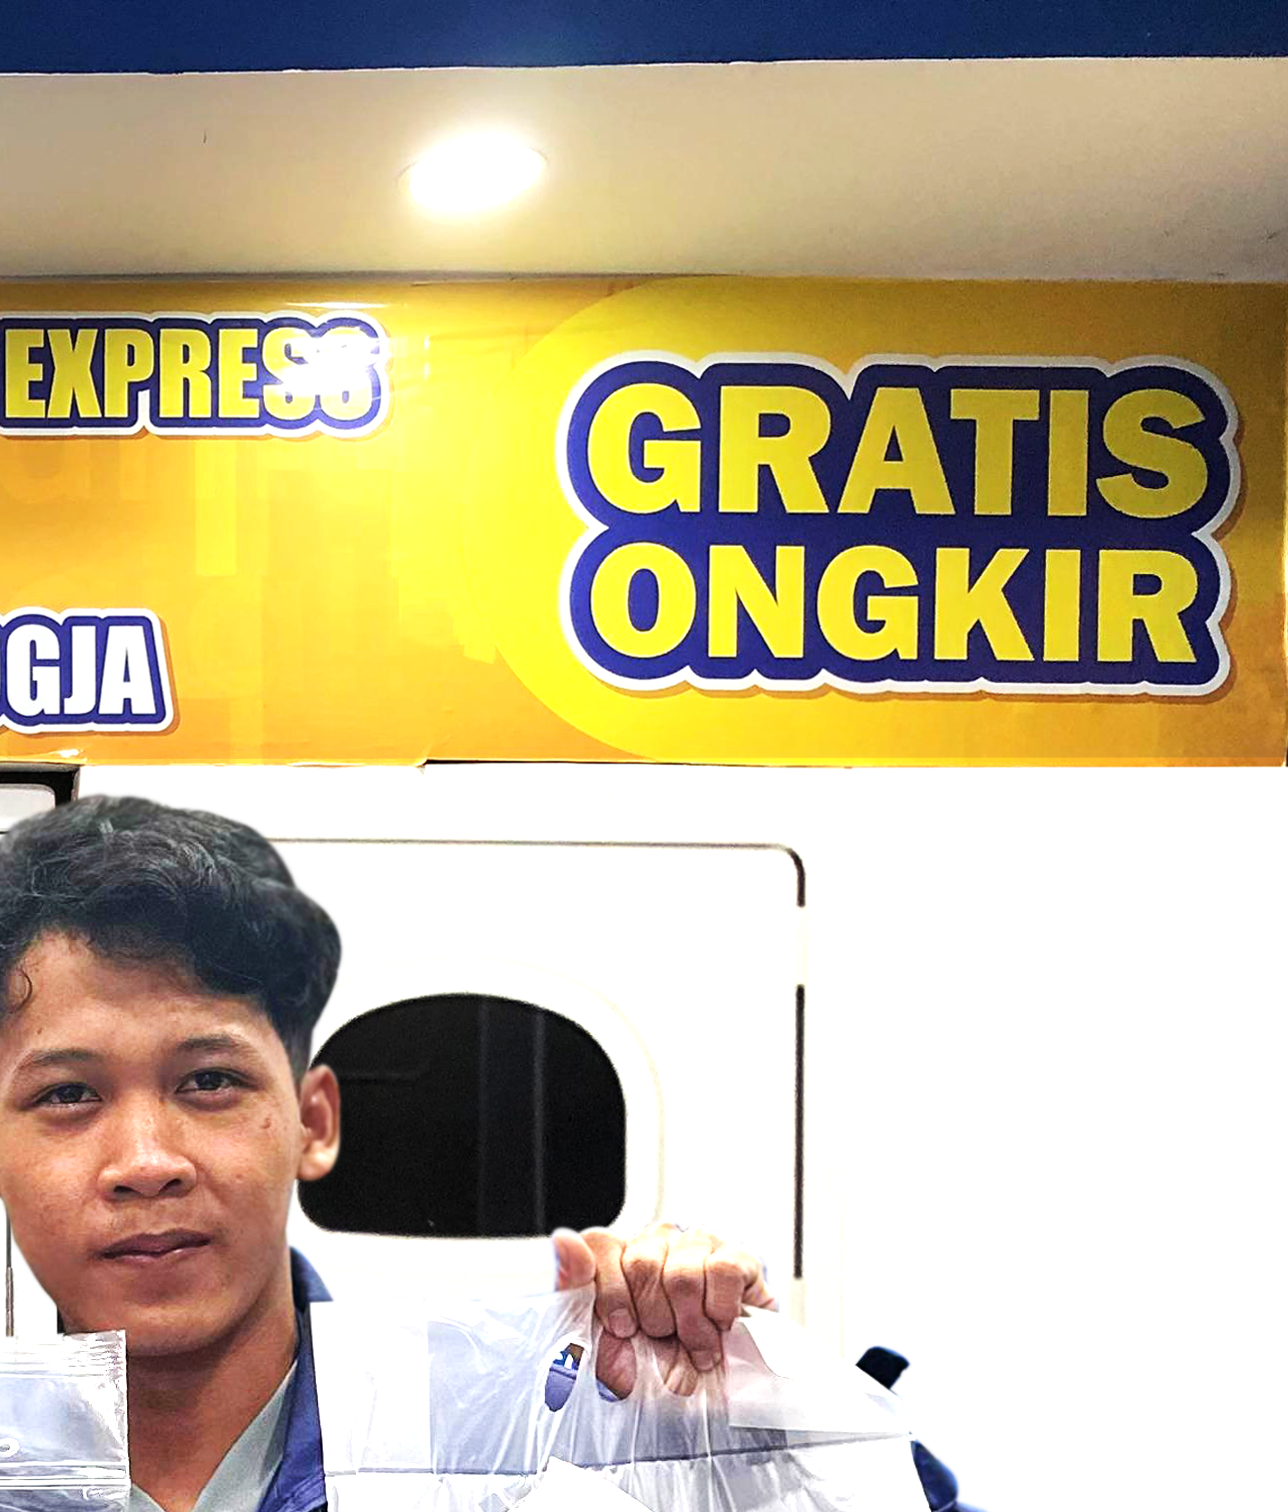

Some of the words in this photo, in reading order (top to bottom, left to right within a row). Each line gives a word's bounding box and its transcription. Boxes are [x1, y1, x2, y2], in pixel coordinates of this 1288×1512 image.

[5, 325, 374, 421] EXPRESS
[586, 381, 1210, 521] GRATIS
[589, 542, 1200, 664] ONGKIR
